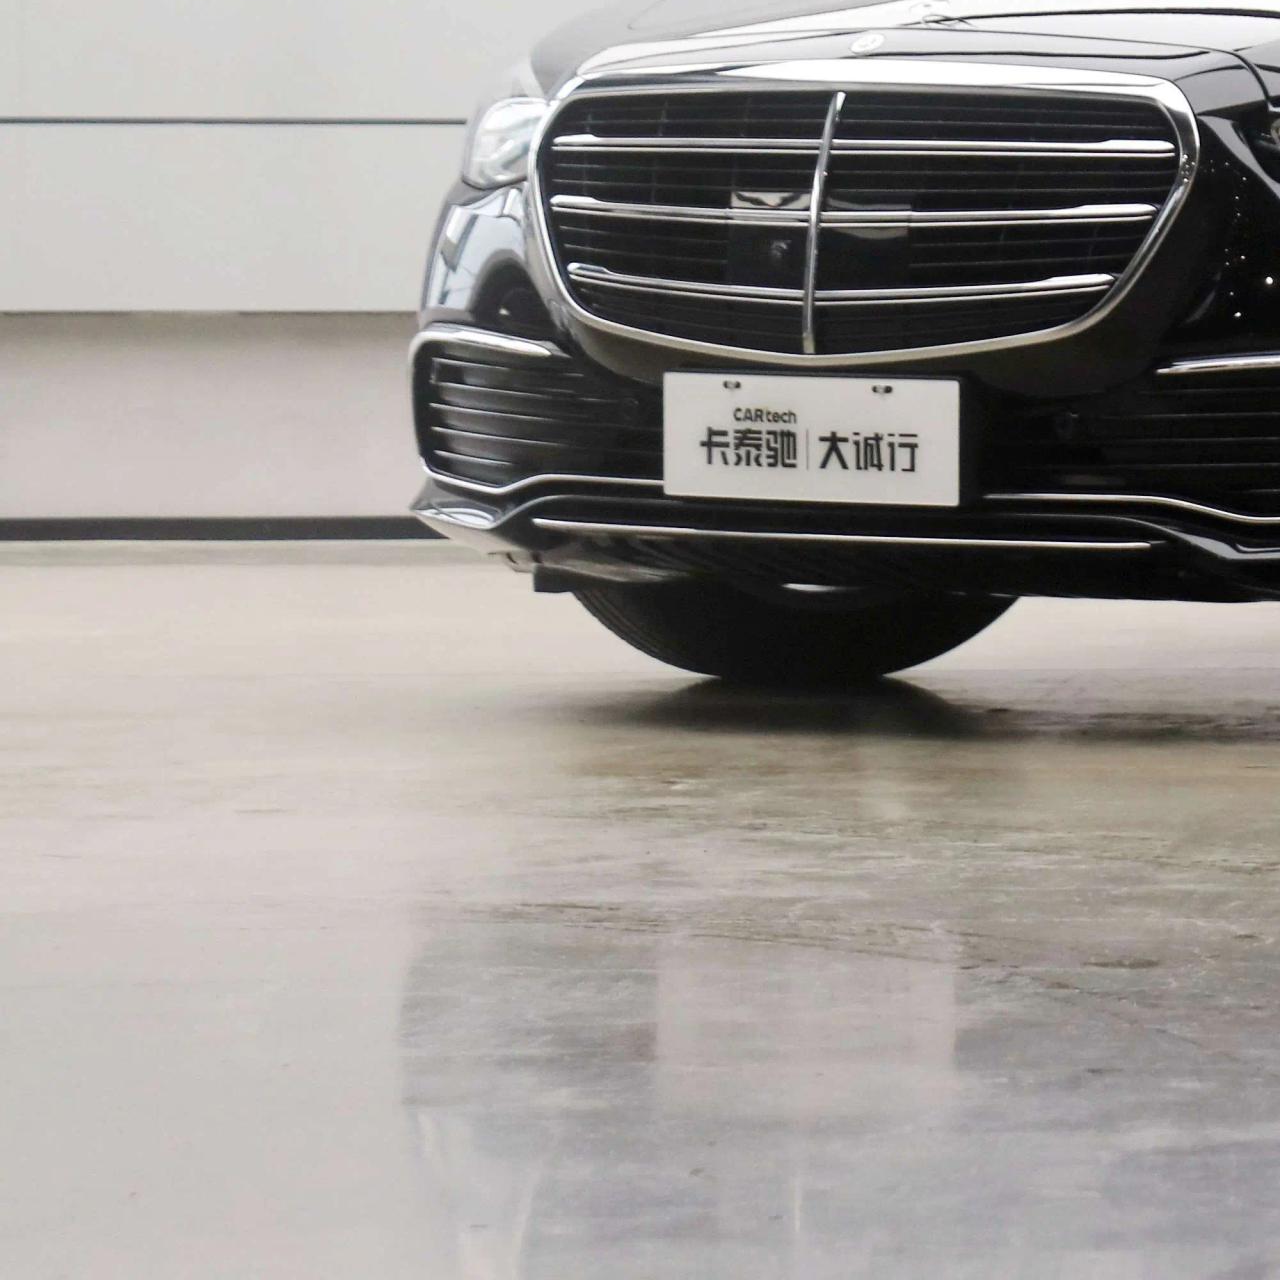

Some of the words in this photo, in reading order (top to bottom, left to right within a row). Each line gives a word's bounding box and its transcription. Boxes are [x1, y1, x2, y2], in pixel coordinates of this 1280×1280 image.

[733, 407, 798, 425] CARtech
[700, 426, 798, 469] 卡泰驰
[818, 430, 919, 473] 大诚行
